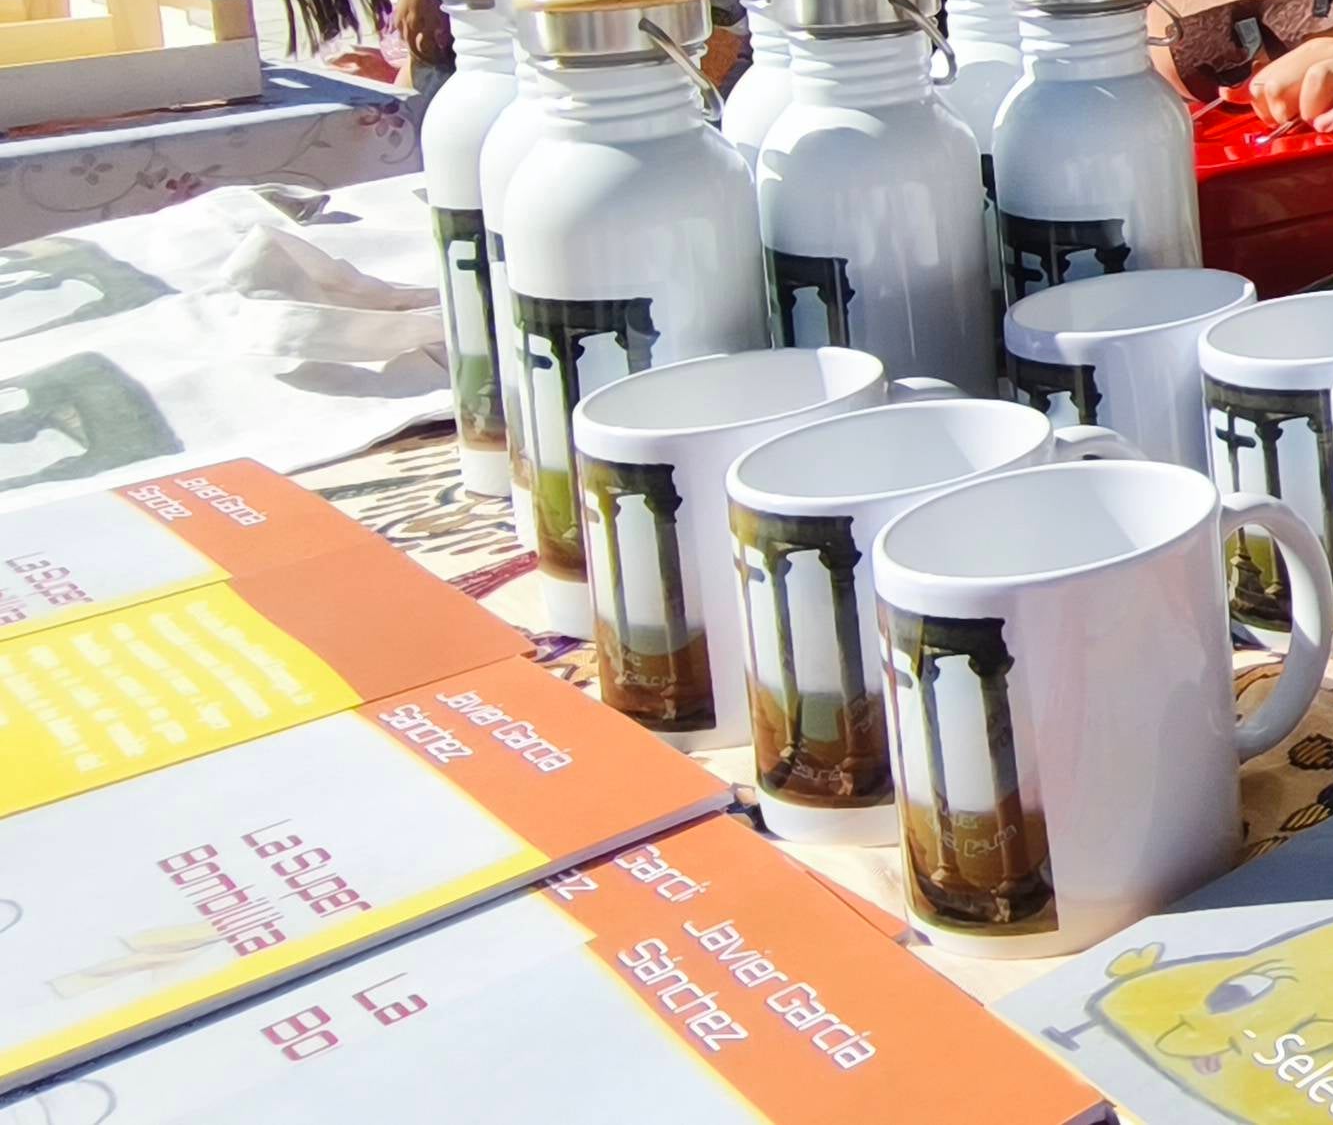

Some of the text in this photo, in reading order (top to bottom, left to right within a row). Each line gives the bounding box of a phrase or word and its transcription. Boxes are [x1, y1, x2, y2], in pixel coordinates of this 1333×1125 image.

[241, 818, 372, 918] La Super
[682, 918, 789, 988] Javier
[351, 971, 429, 1026] La
[616, 937, 750, 1052] Sánchez
[259, 1005, 340, 1062] Bo
